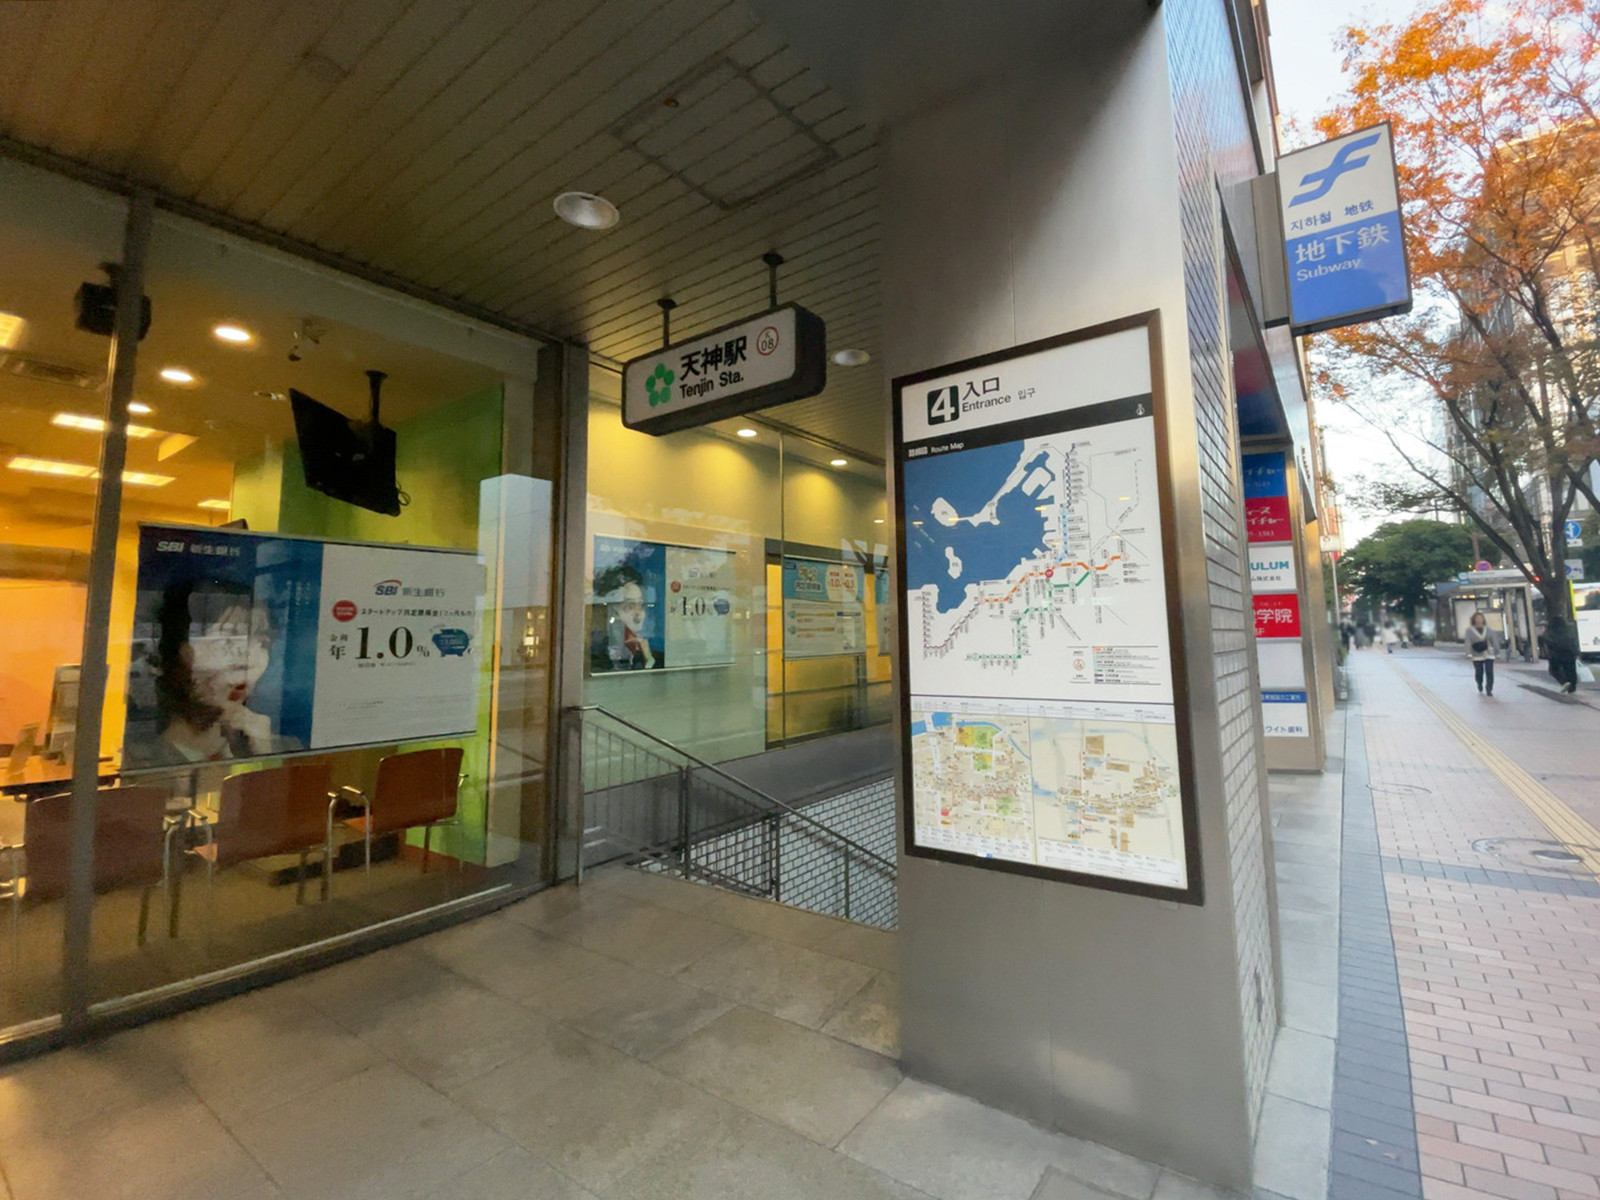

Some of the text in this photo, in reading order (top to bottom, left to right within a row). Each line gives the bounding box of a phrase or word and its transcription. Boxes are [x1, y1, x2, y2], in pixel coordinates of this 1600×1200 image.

[1290, 211, 1332, 231] 지하철
[1296, 223, 1390, 264] 地下鉄
[1296, 257, 1363, 282] Subway
[761, 338, 775, 352] 08
[680, 335, 747, 381] 天神駅
[679, 370, 744, 399] Tenjin Sta.
[962, 377, 1000, 401] 入口
[930, 387, 956, 423] 4
[962, 388, 1036, 412] Entrance 입구
[950, 442, 965, 450] Map
[156, 541, 185, 553] SBI
[1250, 561, 1290, 571] ULUM
[375, 585, 399, 596] SBI
[1253, 607, 1294, 624] 学院
